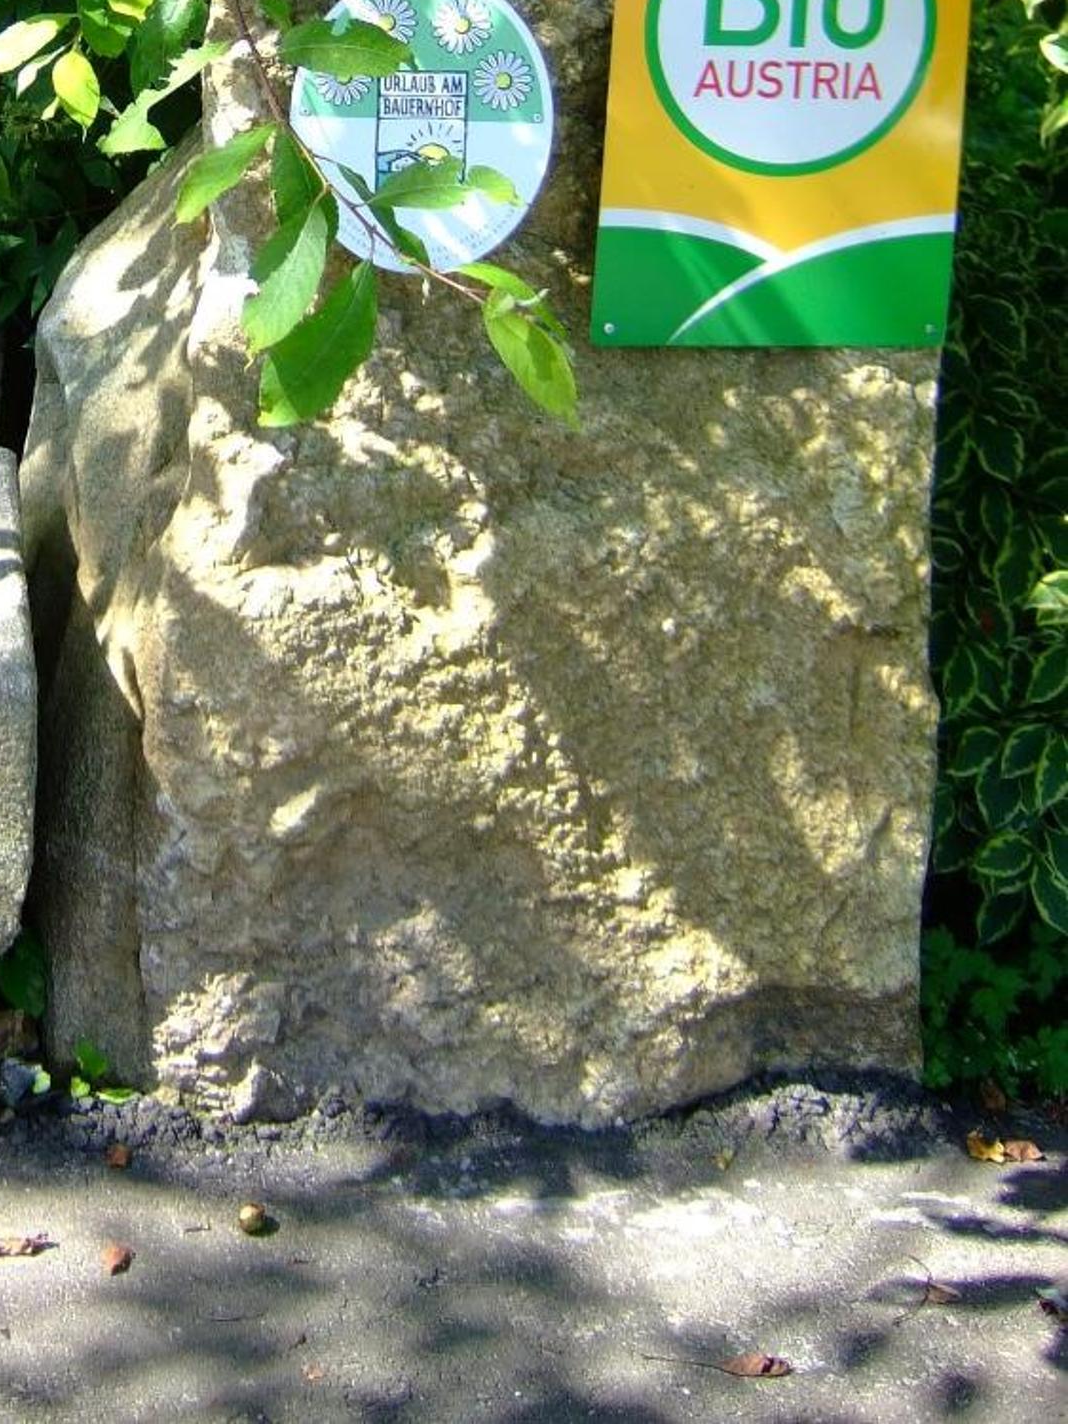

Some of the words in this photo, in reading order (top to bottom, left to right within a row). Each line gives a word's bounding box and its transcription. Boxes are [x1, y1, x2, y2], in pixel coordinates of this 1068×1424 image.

[384, 75, 436, 94] URLAUB
[441, 76, 463, 94] AM
[693, 60, 882, 100] AUSTRIA
[383, 97, 463, 117] BAUERNHOF
